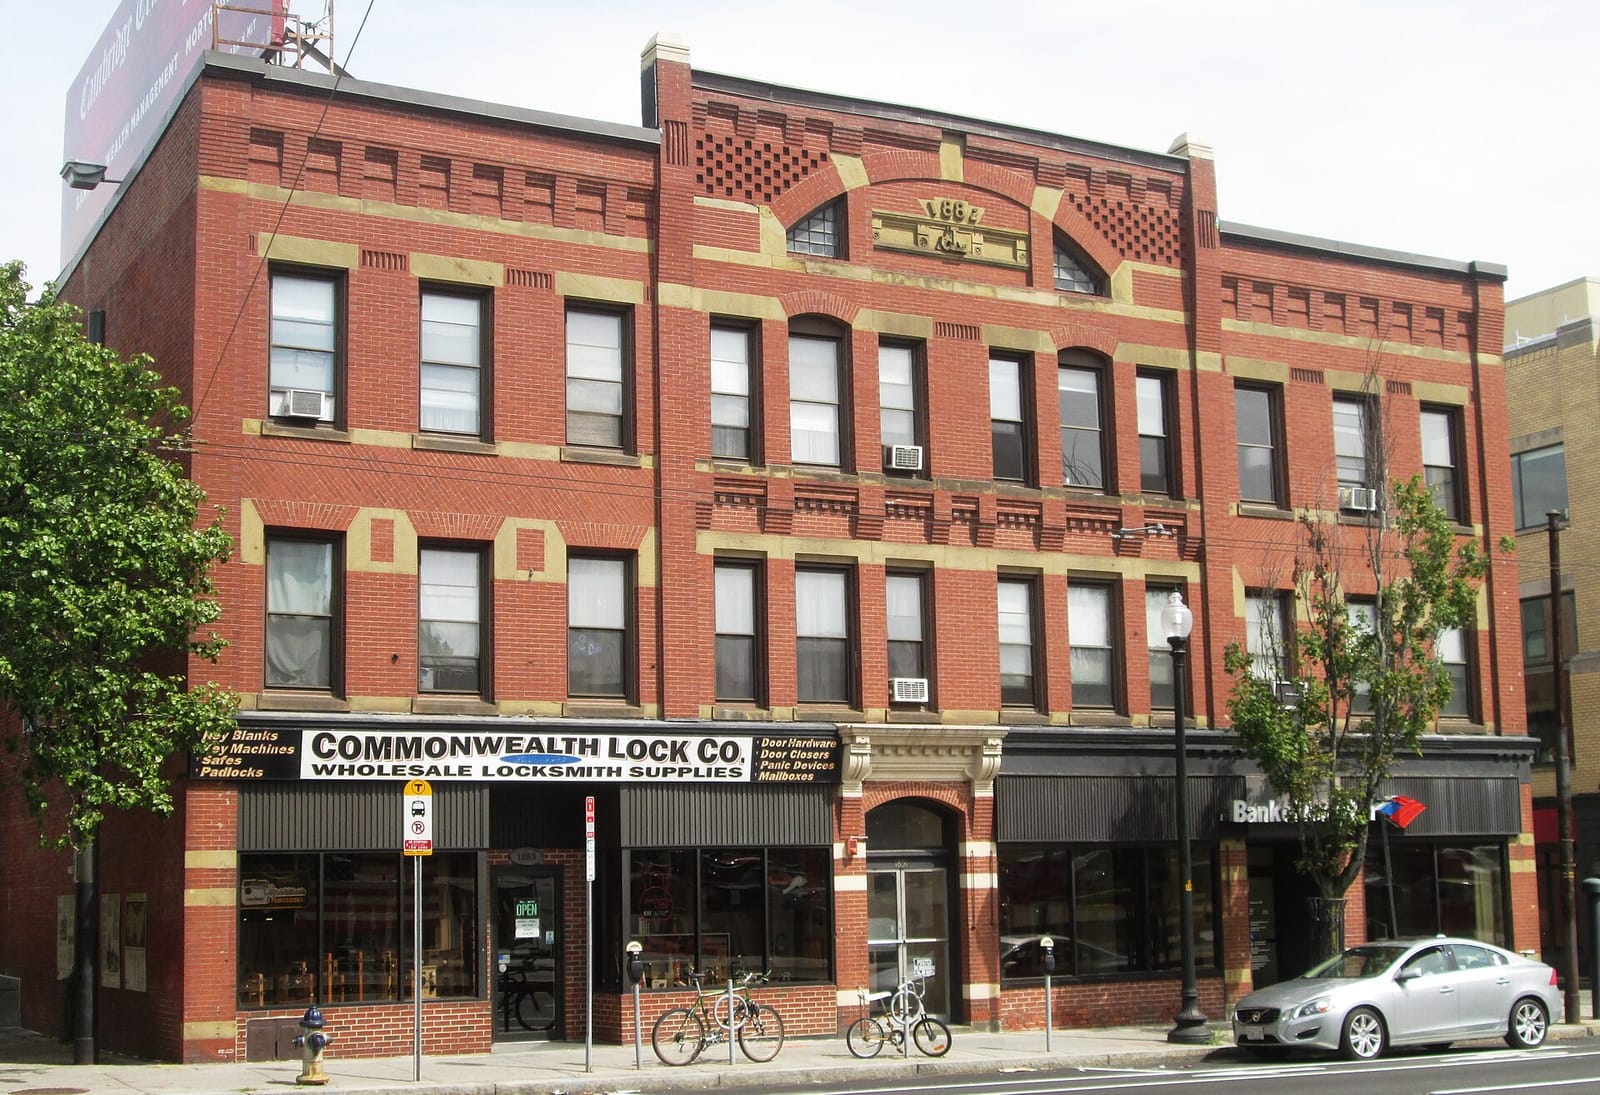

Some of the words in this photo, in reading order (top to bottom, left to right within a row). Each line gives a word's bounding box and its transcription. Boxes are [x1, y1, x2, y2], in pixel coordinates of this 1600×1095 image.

[130, 51, 179, 132] MANAGEMENT
[232, 730, 278, 741] Blanks
[230, 743, 295, 754] Machines
[312, 733, 599, 760] COMMONWEALTH
[608, 737, 690, 762] LOCK
[697, 738, 745, 763] CO.
[761, 738, 787, 747] Door
[788, 738, 837, 748] Hardware
[760, 749, 787, 758] Door
[790, 750, 829, 759] Closers
[201, 755, 242, 765] Safes
[760, 760, 791, 769] Panic
[793, 760, 835, 770] Devices
[200, 766, 263, 777] Padlocks
[312, 764, 472, 776] WHOLESALE
[482, 765, 622, 777] LOCKSMITH
[629, 766, 743, 777] SUPPLIES
[759, 771, 814, 780] Mailboxes
[1233, 799, 1282, 823] Bank
[516, 903, 537, 916] OPEN
